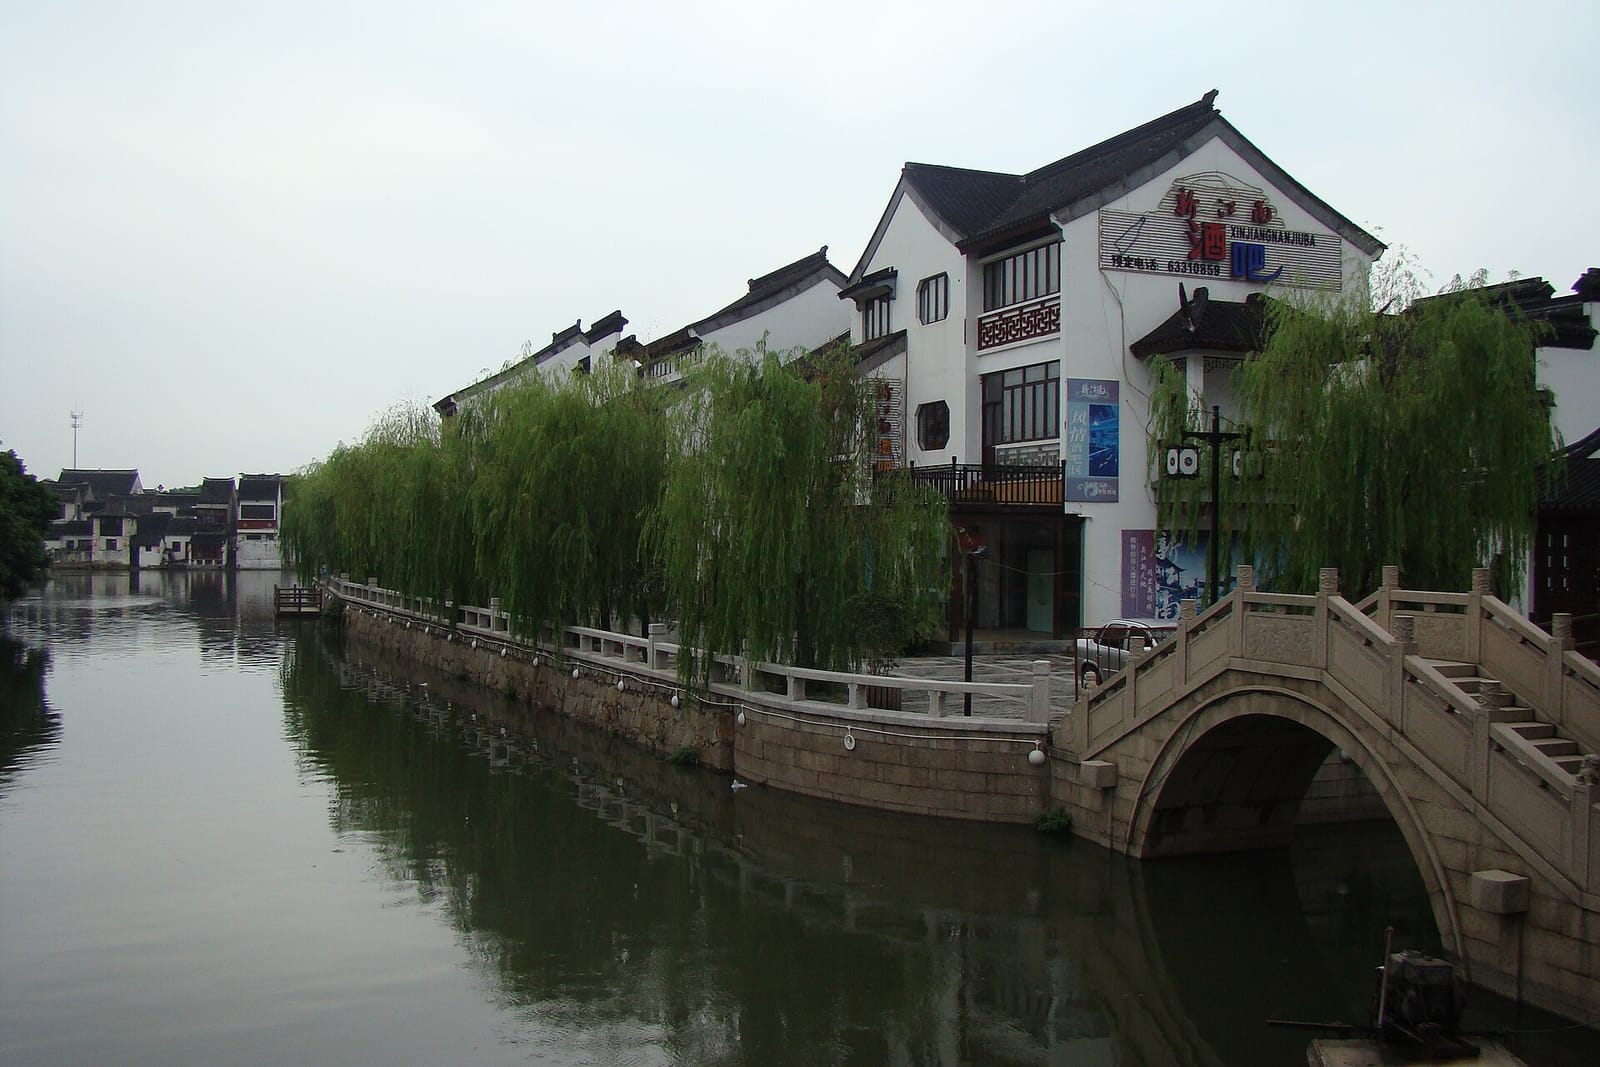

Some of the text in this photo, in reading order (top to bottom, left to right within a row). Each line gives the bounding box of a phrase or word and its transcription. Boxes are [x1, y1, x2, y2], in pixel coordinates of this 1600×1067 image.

[1174, 187, 1272, 224] 新江南
[1230, 224, 1315, 246] XINJIANGNANJIUBA
[1185, 220, 1283, 280] 酒吧
[1167, 260, 1220, 276] 63310859
